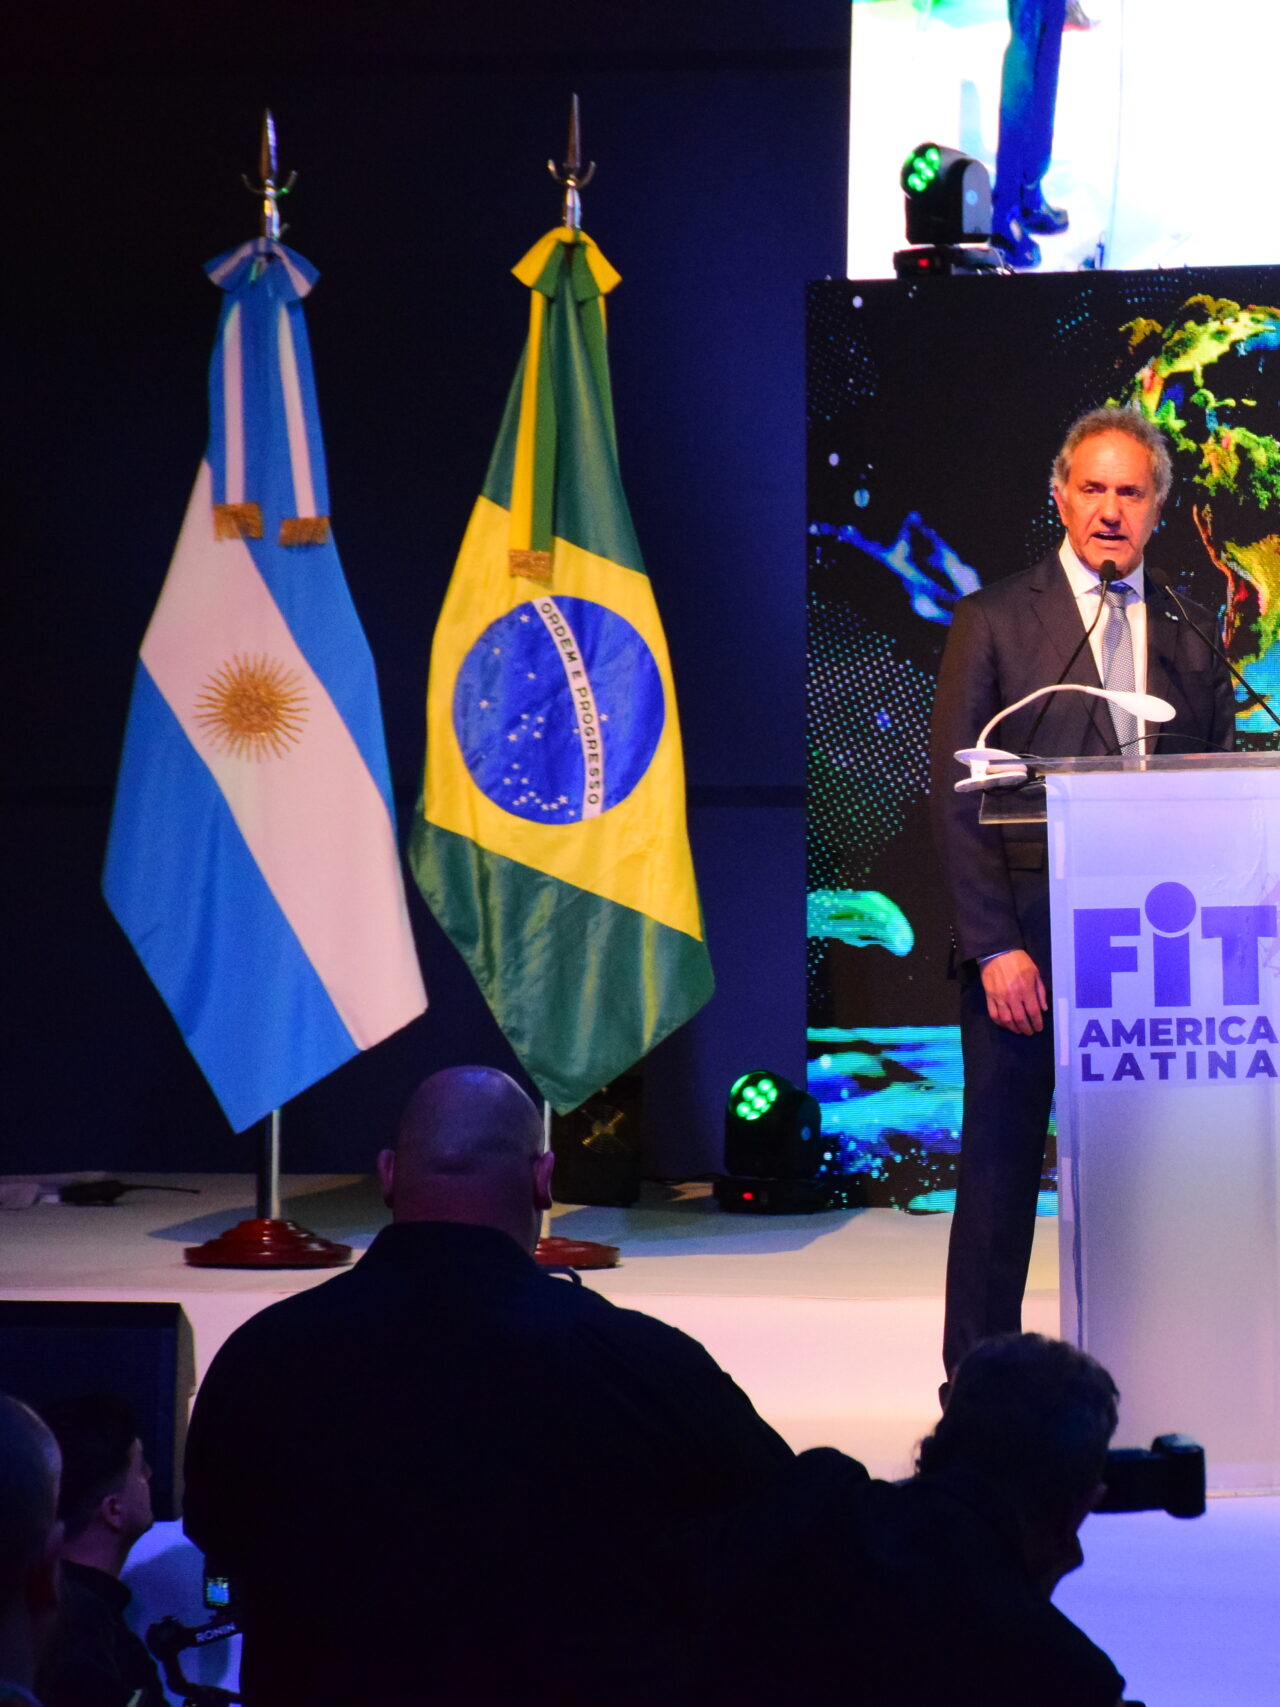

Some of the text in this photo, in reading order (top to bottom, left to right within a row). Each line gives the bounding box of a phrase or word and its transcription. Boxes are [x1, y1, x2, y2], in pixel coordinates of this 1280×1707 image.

[541, 602, 600, 805] ORDEM E PROGRESSO
[1078, 1016, 1279, 1047] AMERICA
[1081, 1050, 1279, 1082] LATINA
[195, 1622, 237, 1643] RONIN
